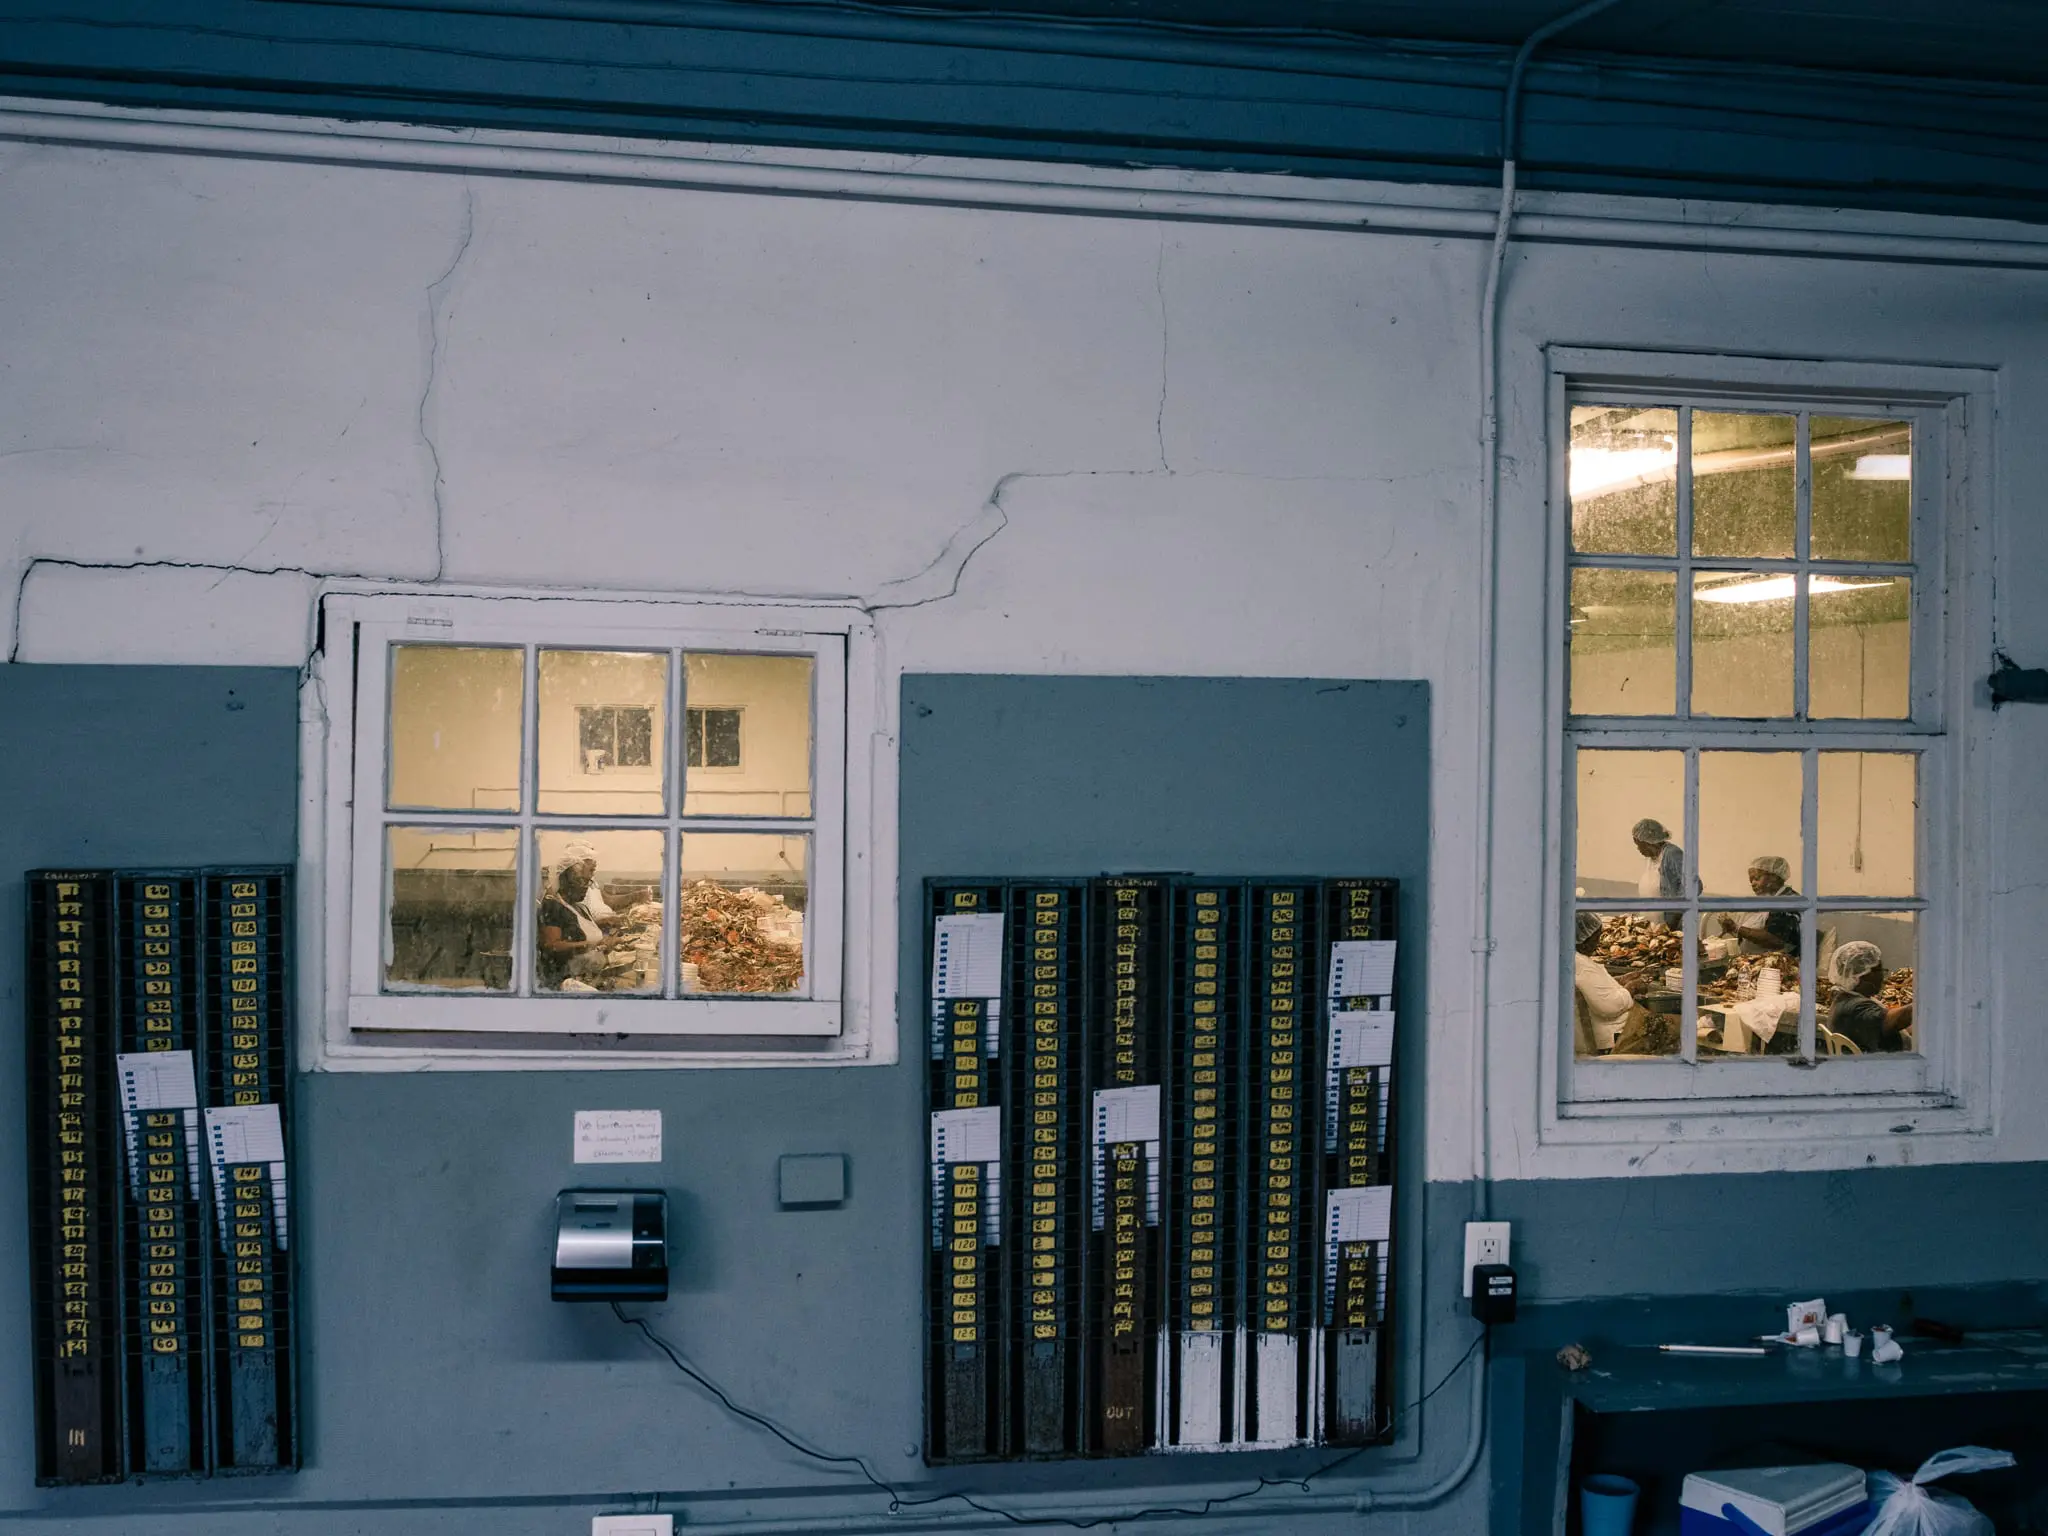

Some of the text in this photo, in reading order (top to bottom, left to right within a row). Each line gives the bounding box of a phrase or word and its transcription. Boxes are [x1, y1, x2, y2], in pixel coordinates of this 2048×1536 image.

[233, 885, 254, 894] 126
[959, 895, 973, 904] 101
[1039, 896, 1055, 904] 201
[1276, 895, 1291, 904] 301
[149, 906, 165, 915] 27
[1037, 914, 1057, 923] 202
[1273, 911, 1292, 920] 302
[149, 925, 167, 934] 28
[1038, 931, 1057, 941] 203
[1273, 930, 1292, 939] 303
[149, 944, 166, 954] 29
[236, 942, 253, 952] 129
[1038, 949, 1057, 959] 204
[150, 963, 166, 972] 30
[152, 982, 166, 992] 31
[1036, 985, 1057, 995] 206
[152, 1002, 170, 1010] 32
[958, 1004, 976, 1012] 107
[1037, 1003, 1056, 1013] 207
[153, 1019, 168, 1027] 33
[235, 1016, 255, 1026] 133
[959, 1022, 975, 1031] 108
[153, 1039, 169, 1048] 34
[237, 1036, 256, 1045] 134
[958, 1040, 975, 1050] 109
[69, 1055, 80, 1065] 10
[237, 1055, 257, 1065] 135
[1038, 1056, 1054, 1066] 210
[1274, 1052, 1291, 1061] 310
[68, 1075, 78, 1085] 11
[238, 1074, 257, 1083] 136
[958, 1077, 973, 1085] 111
[1037, 1075, 1054, 1085] 211
[68, 1094, 81, 1103] 12
[239, 1093, 258, 1102] 137
[959, 1094, 976, 1103] 112
[1037, 1094, 1055, 1103] 212
[154, 1115, 169, 1125] 38
[1036, 1112, 1054, 1122] 213
[68, 1132, 80, 1141] 14
[1037, 1130, 1056, 1139] 214
[67, 1152, 81, 1162] 15
[155, 1153, 169, 1162] 40
[70, 1168, 81, 1178] 16
[240, 1168, 259, 1177] 141
[959, 1168, 976, 1176] 116
[1037, 1164, 1055, 1174] 216
[155, 1171, 168, 1180] 41
[70, 1189, 81, 1198] 17
[153, 1190, 170, 1200] 42
[239, 1187, 259, 1196] 142
[959, 1186, 976, 1195] 117
[70, 1208, 80, 1217] 18
[240, 1205, 259, 1215] 143
[959, 1204, 975, 1213] 118
[153, 1210, 169, 1218] 43
[154, 1226, 171, 1235] 44
[959, 1222, 975, 1231] 119
[69, 1227, 80, 1237] 19
[958, 1240, 975, 1249] 120
[70, 1245, 83, 1254] 20
[239, 1261, 261, 1271] 146
[957, 1258, 973, 1267] 121
[155, 1264, 171, 1274] 46
[69, 1284, 82, 1292] 22
[156, 1283, 171, 1293] 47
[959, 1294, 976, 1303] 123
[70, 1302, 83, 1311] 23
[155, 1302, 172, 1312] 48
[957, 1328, 975, 1338] 125
[1106, 1405, 1135, 1420] OUT
[69, 1428, 85, 1446] IN
